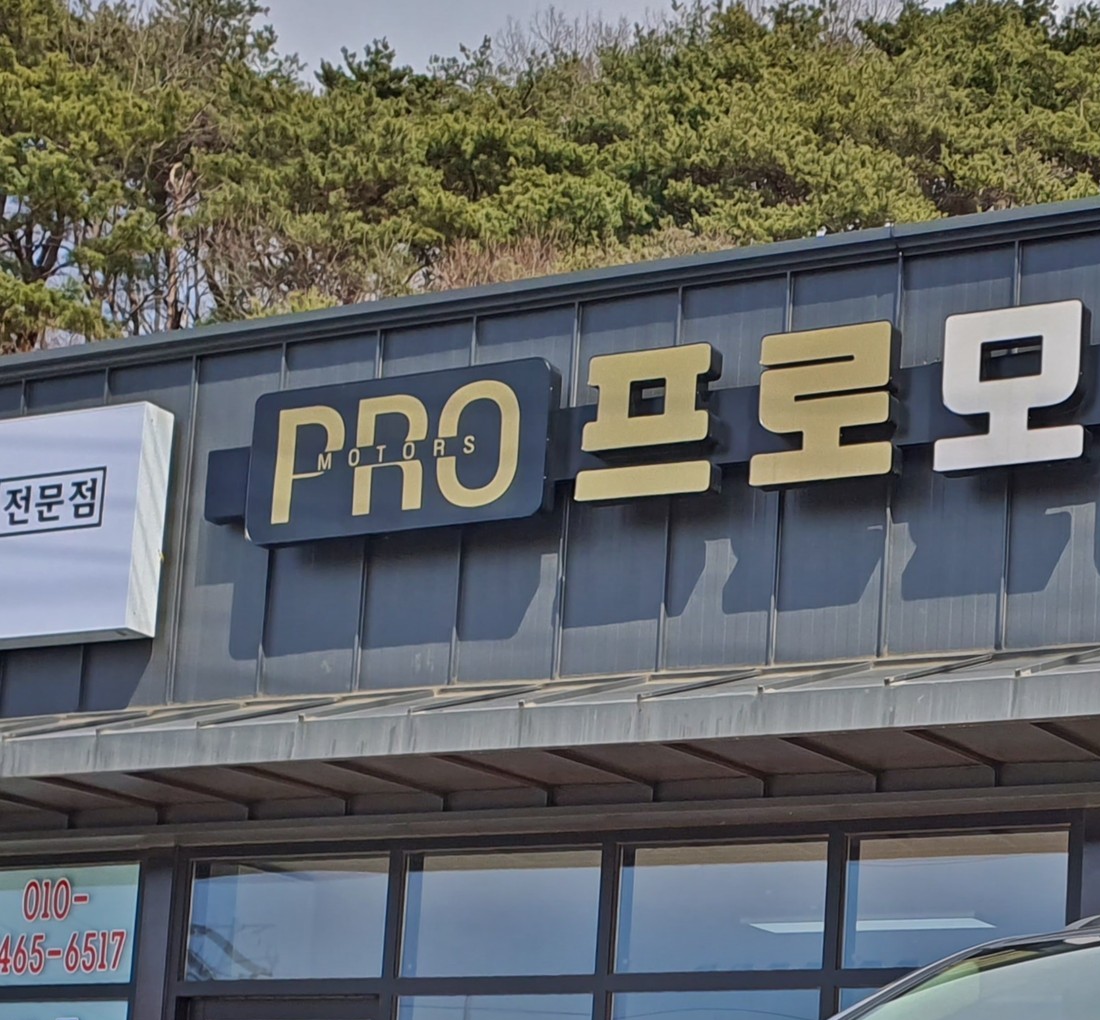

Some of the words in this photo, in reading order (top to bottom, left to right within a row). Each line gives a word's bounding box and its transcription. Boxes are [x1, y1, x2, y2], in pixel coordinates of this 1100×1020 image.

[270, 380, 521, 525] PRO
[317, 434, 476, 471] MOTORS
[4, 477, 98, 526] 전문점
[22, 877, 89, 922] 010-
